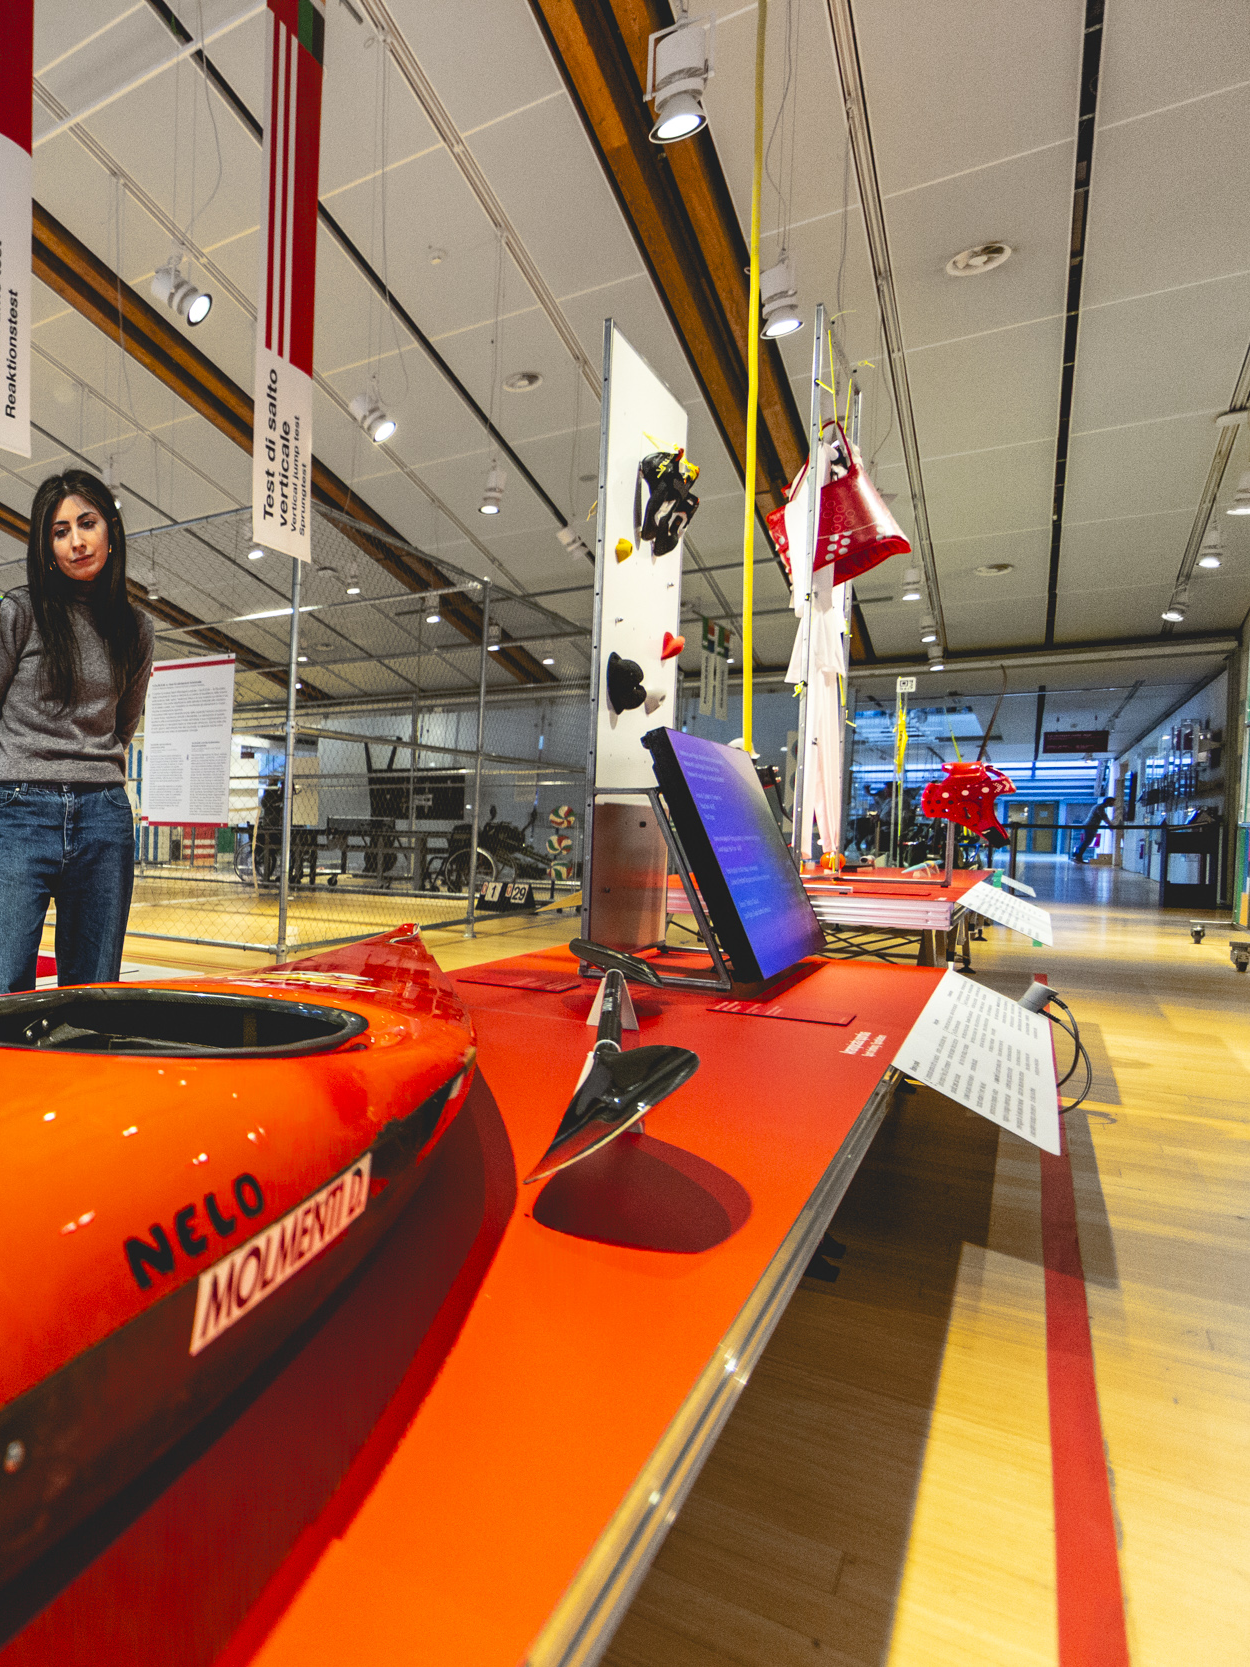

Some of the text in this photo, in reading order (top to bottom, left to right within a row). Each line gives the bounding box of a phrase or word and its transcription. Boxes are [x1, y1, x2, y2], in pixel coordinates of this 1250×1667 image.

[5, 289, 18, 419] Reaktionstest
[263, 368, 278, 521] Test di salto
[279, 421, 291, 528] verticale
[290, 415, 301, 532] Vertical jump test
[299, 463, 307, 537] Sprungtest
[512, 886, 526, 900] 29
[123, 1172, 265, 1290] NELO
